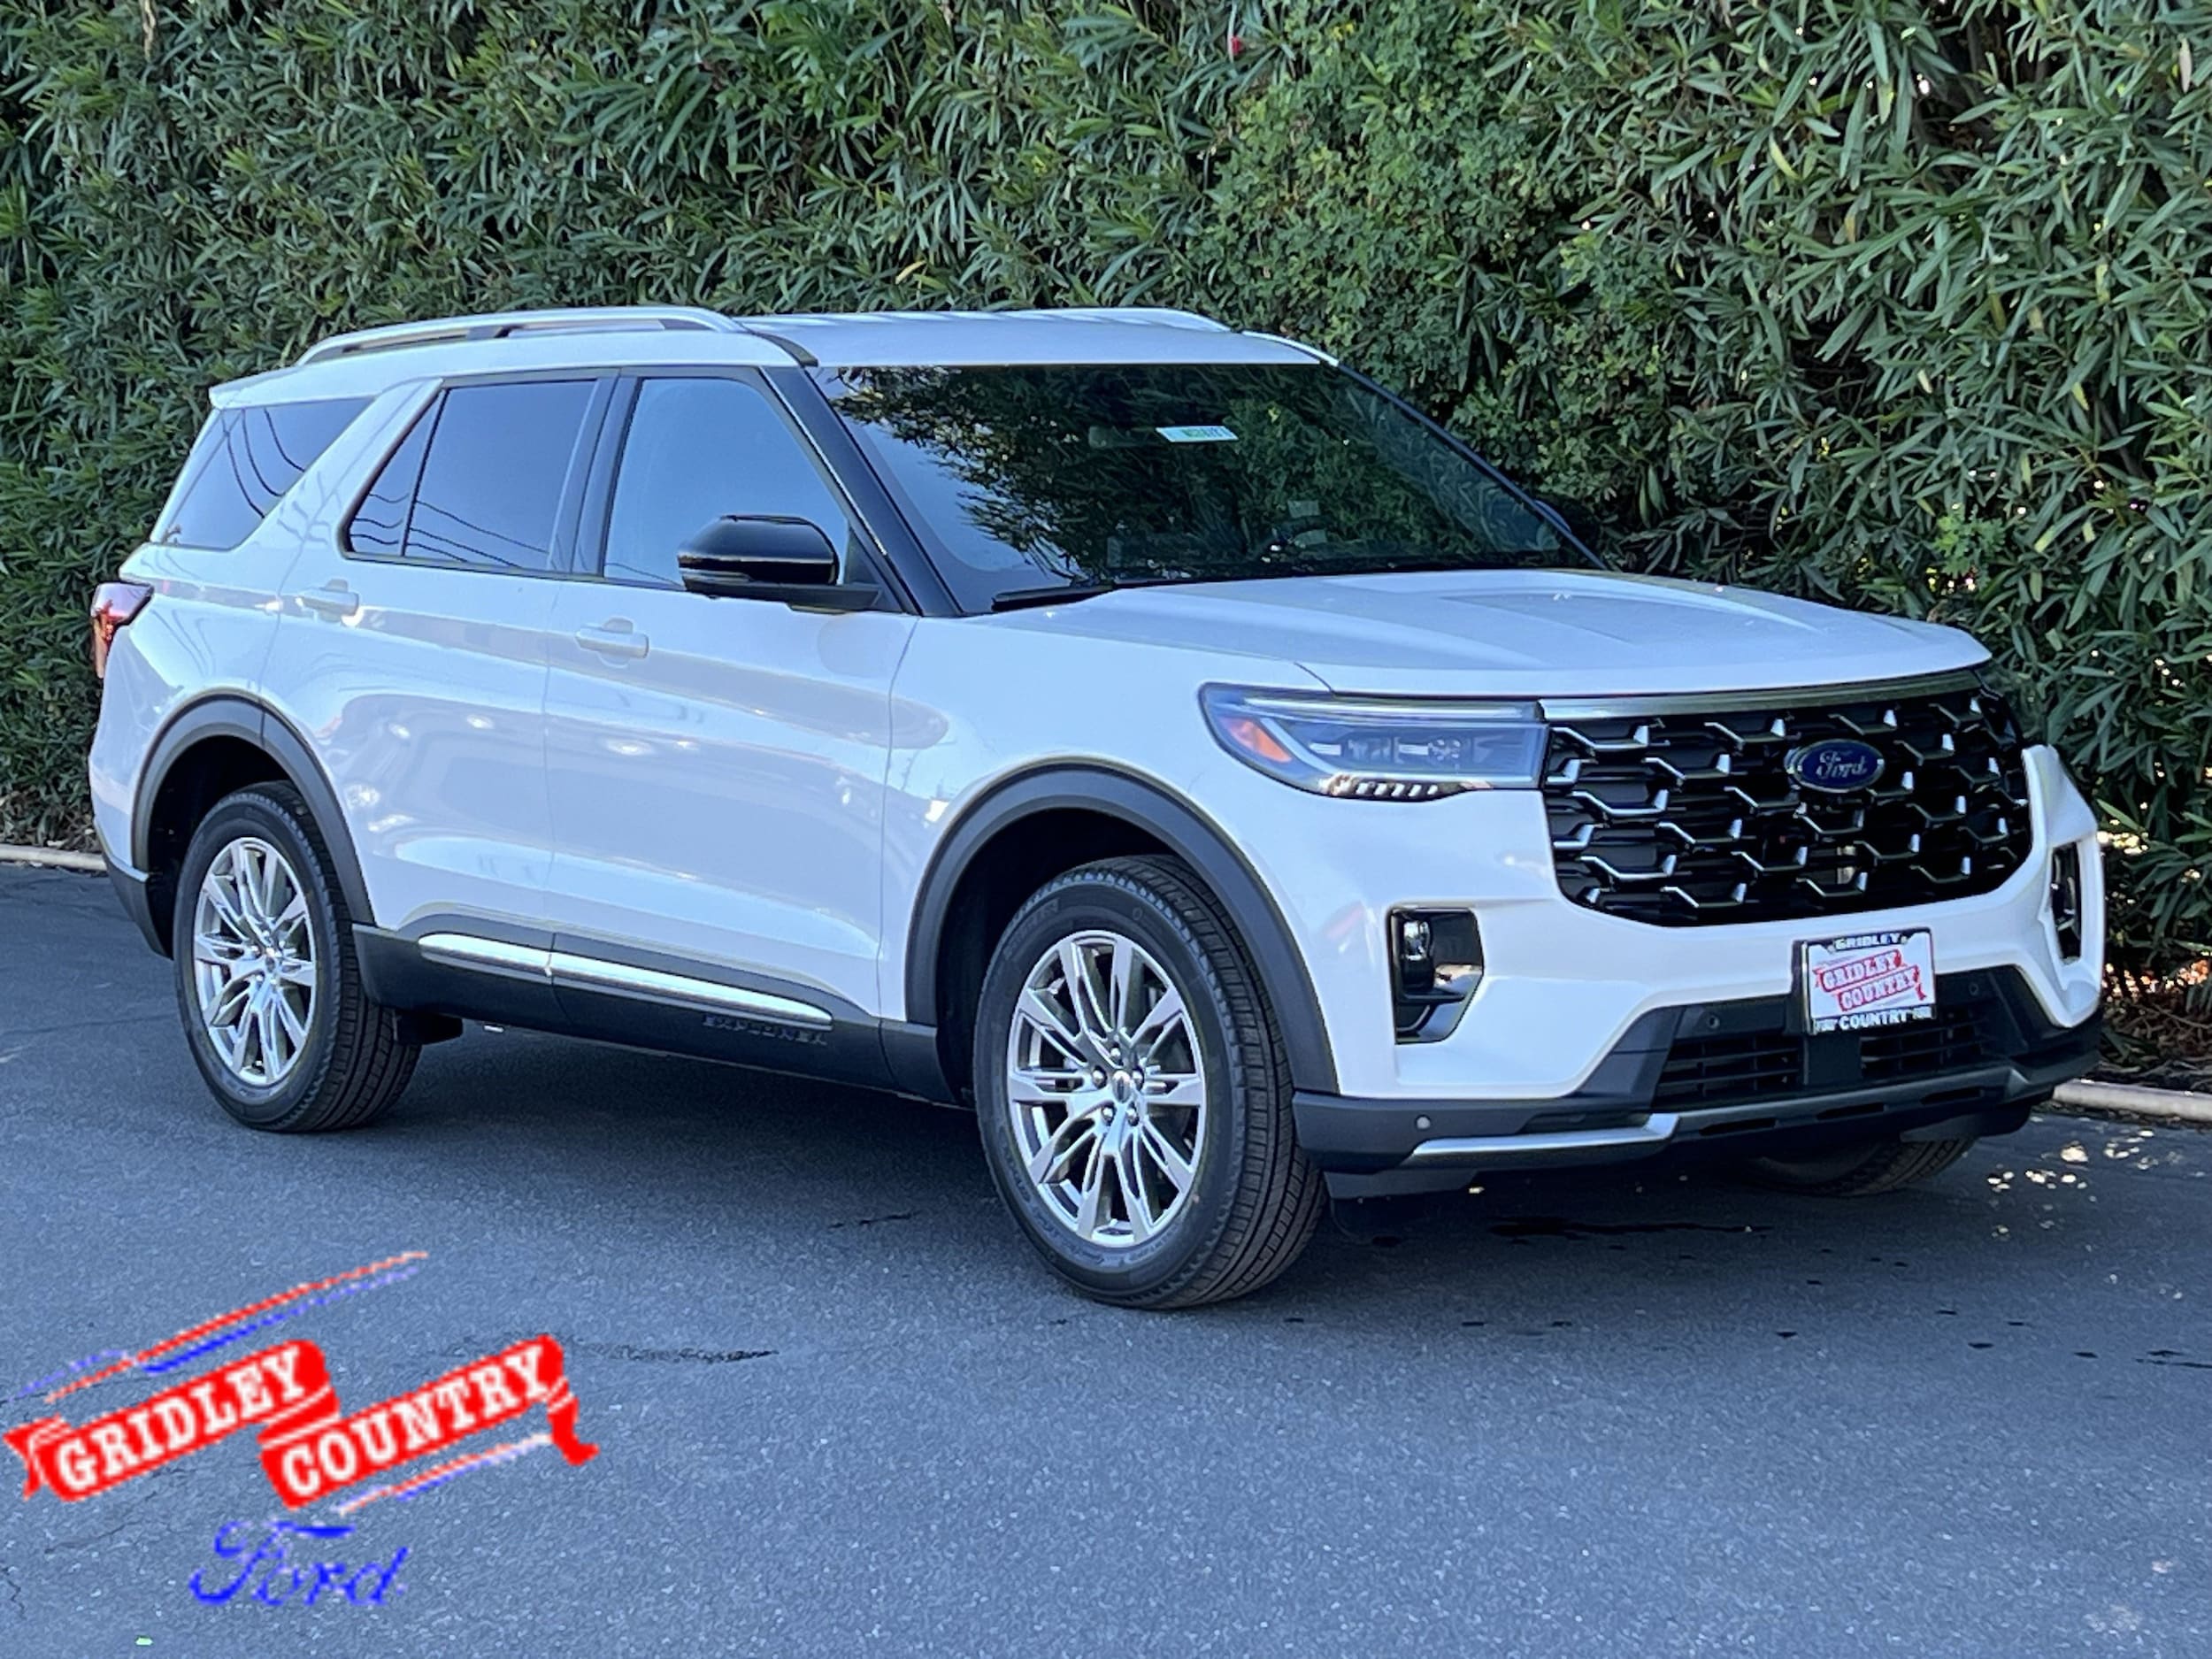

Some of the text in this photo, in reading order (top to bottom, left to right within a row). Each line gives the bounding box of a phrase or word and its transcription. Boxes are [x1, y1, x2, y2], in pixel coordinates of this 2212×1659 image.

[1816, 750, 1867, 780] Ford
[1834, 932, 1901, 949] GRIDLEY
[1824, 952, 1897, 987] GRIDLEY
[1840, 968, 1916, 1008] COUNTRY
[1839, 1010, 1908, 1030] COUNTRY
